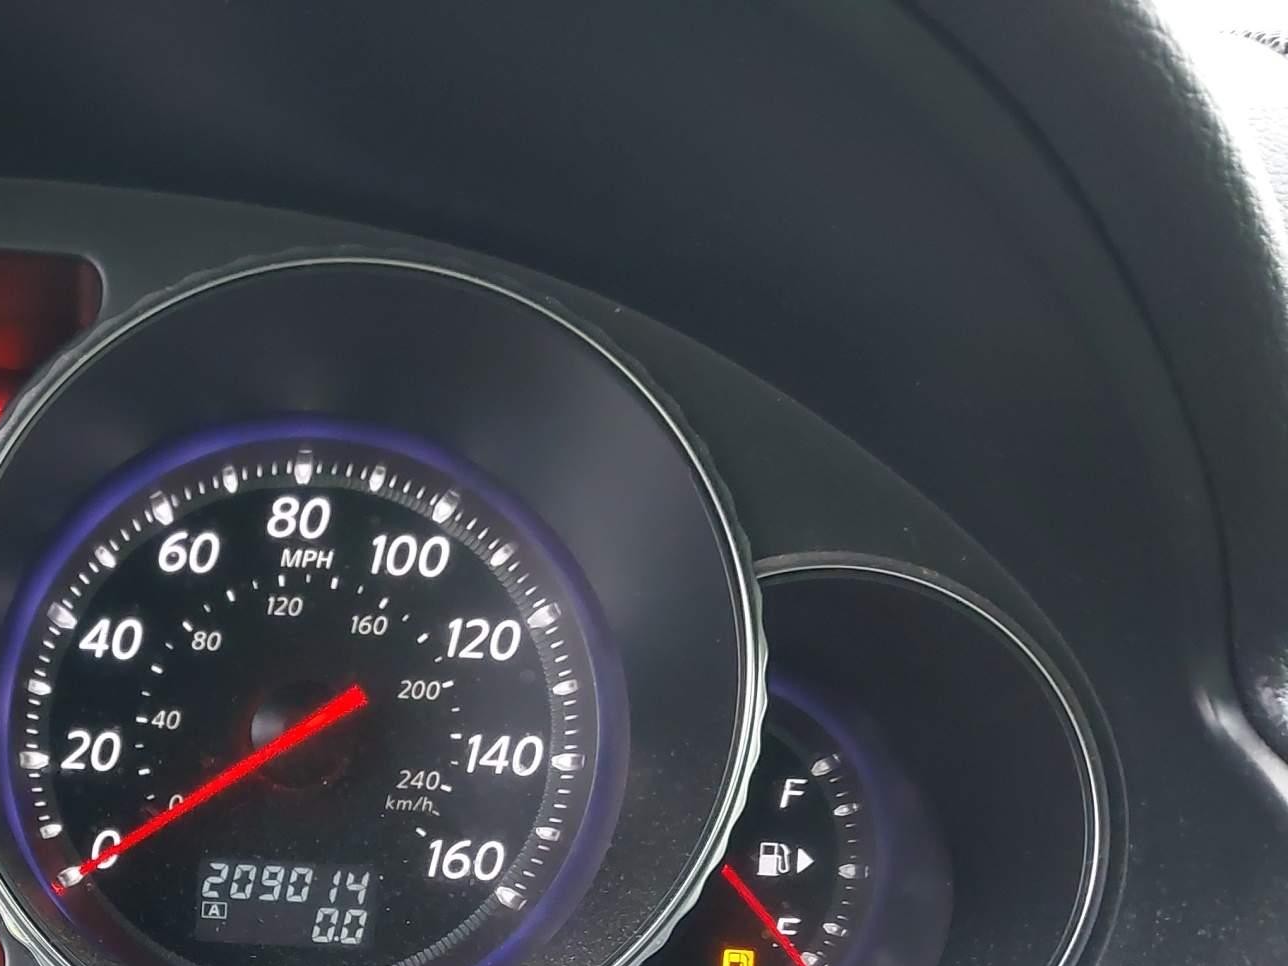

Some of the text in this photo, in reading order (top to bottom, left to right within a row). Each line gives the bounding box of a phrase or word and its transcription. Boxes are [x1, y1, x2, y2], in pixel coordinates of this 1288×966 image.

[267, 496, 330, 539] 80
[159, 531, 220, 573] 60
[281, 548, 334, 569] MPH
[371, 535, 450, 577] 100
[268, 596, 303, 616] 120
[79, 618, 143, 660] 40
[192, 631, 221, 651] 80
[351, 615, 388, 635] 160
[448, 618, 521, 661] 120
[398, 680, 440, 700] 200
[151, 710, 181, 729] 40
[61, 730, 121, 771] 20
[467, 733, 544, 776] 140
[396, 770, 440, 790] 240
[780, 779, 807, 808] F
[92, 830, 121, 869] 0
[428, 840, 506, 881] 160
[202, 863, 369, 904] 209014
[208, 904, 220, 916] A
[312, 908, 367, 944] 0.0
